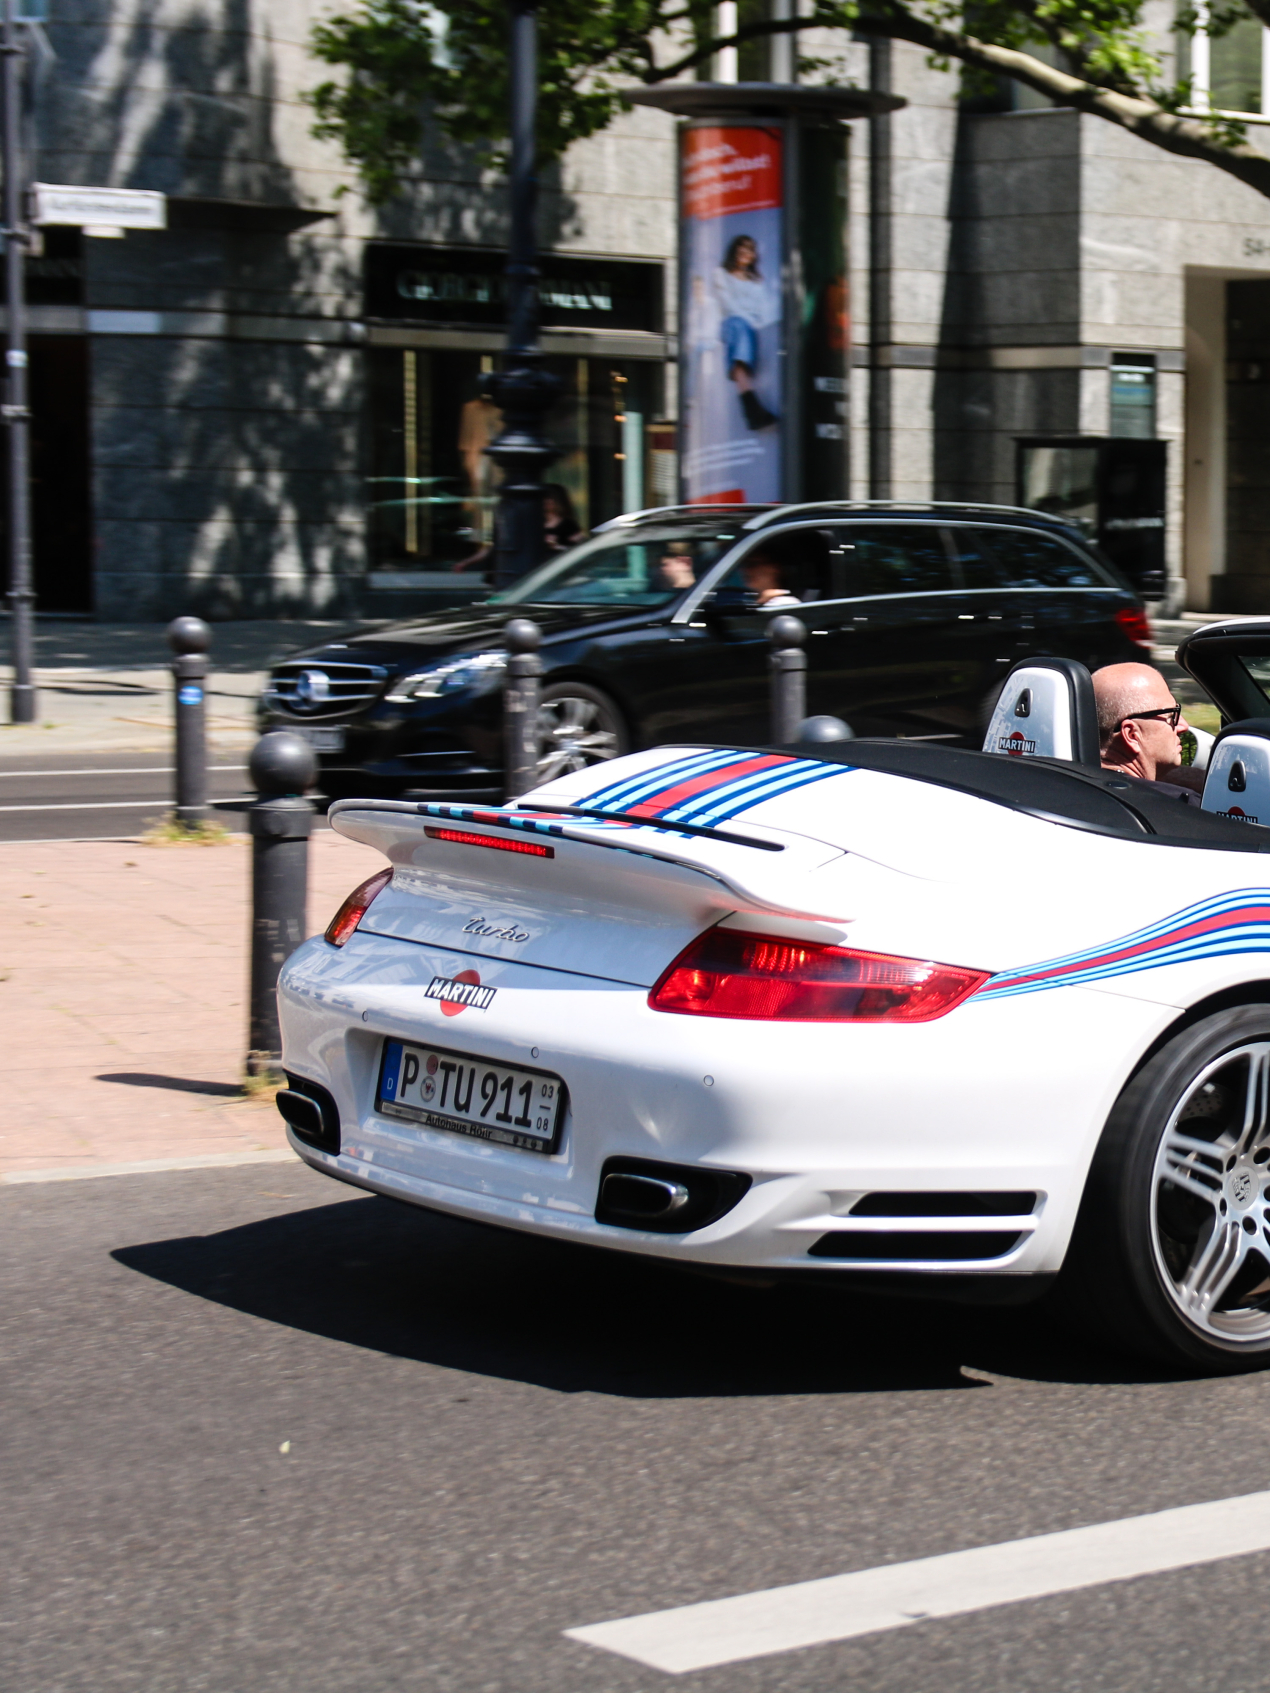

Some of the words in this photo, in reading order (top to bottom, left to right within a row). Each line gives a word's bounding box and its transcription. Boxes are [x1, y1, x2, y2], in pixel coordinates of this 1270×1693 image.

[999, 737, 1035, 753] MARTINI
[462, 916, 530, 943] turbo
[426, 978, 496, 1009] MARTINI
[386, 1077, 394, 1090] D
[400, 1052, 419, 1098] P
[541, 1084, 554, 1099] 03
[425, 1113, 467, 1133] Autohaus
[536, 1116, 549, 1131] 08
